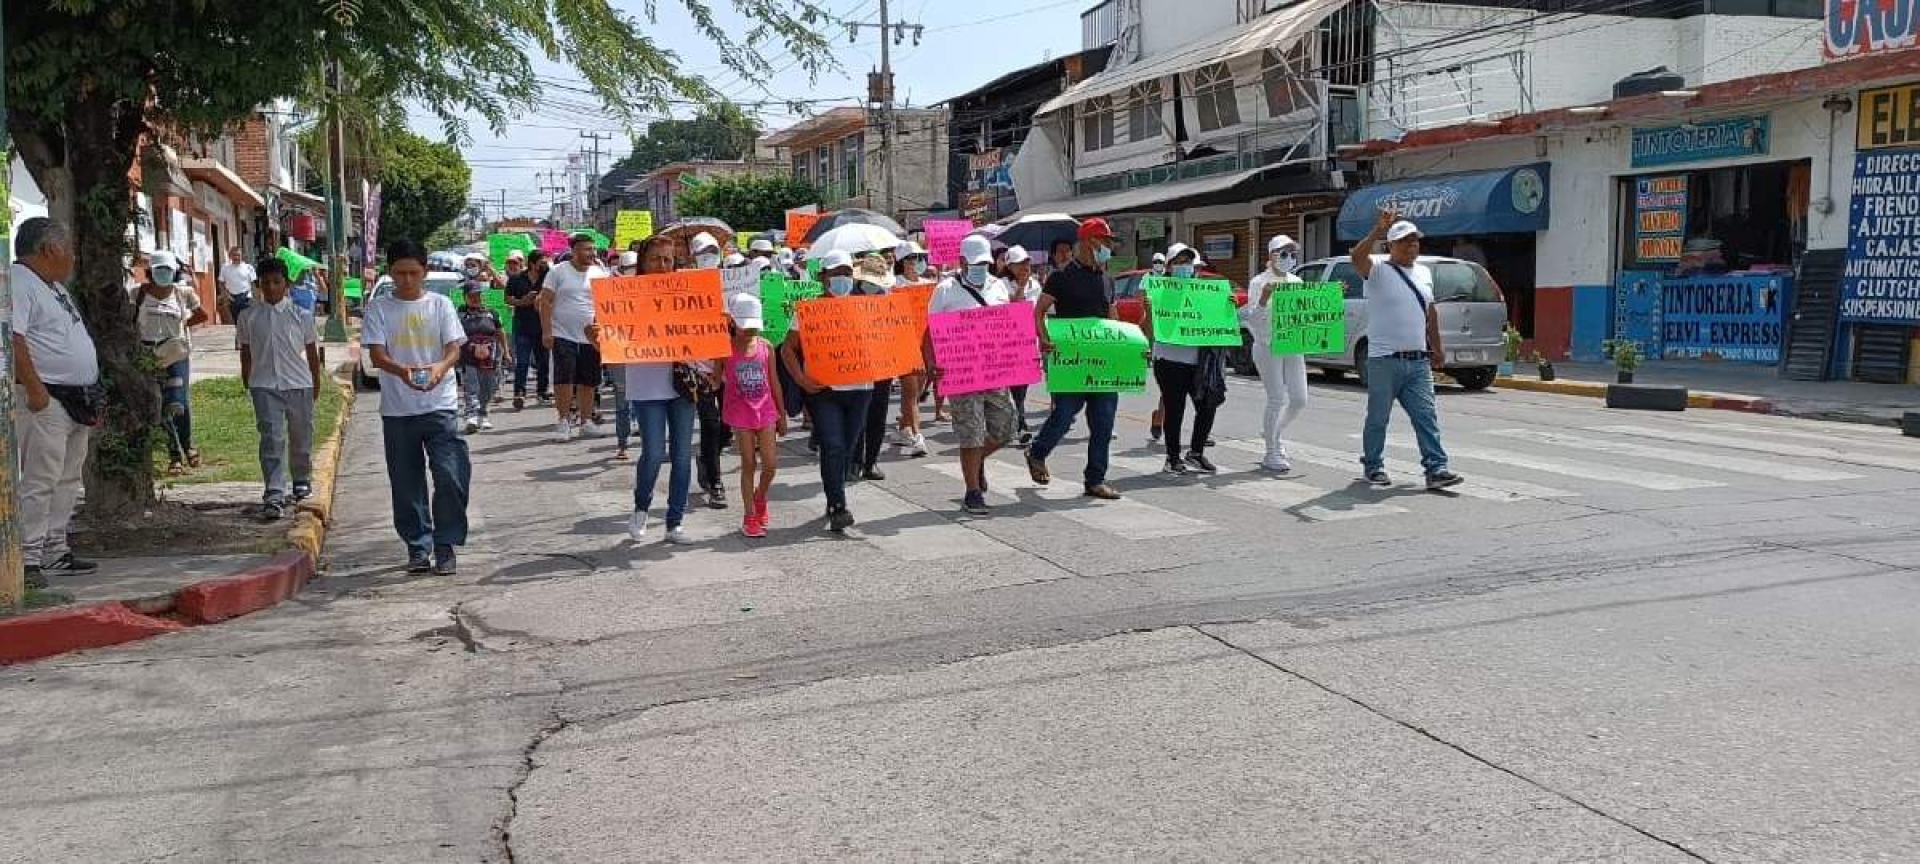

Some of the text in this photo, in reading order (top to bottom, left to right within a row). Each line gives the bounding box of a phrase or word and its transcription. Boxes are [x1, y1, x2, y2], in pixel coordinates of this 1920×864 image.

[1865, 153, 1920, 174] DIRECC
[1844, 258, 1920, 278] AUTOMATIC
[1857, 279, 1920, 299] CLUTCH
[653, 296, 663, 312] Y
[647, 324, 657, 338] A
[1710, 321, 1781, 345] EXPRESS
